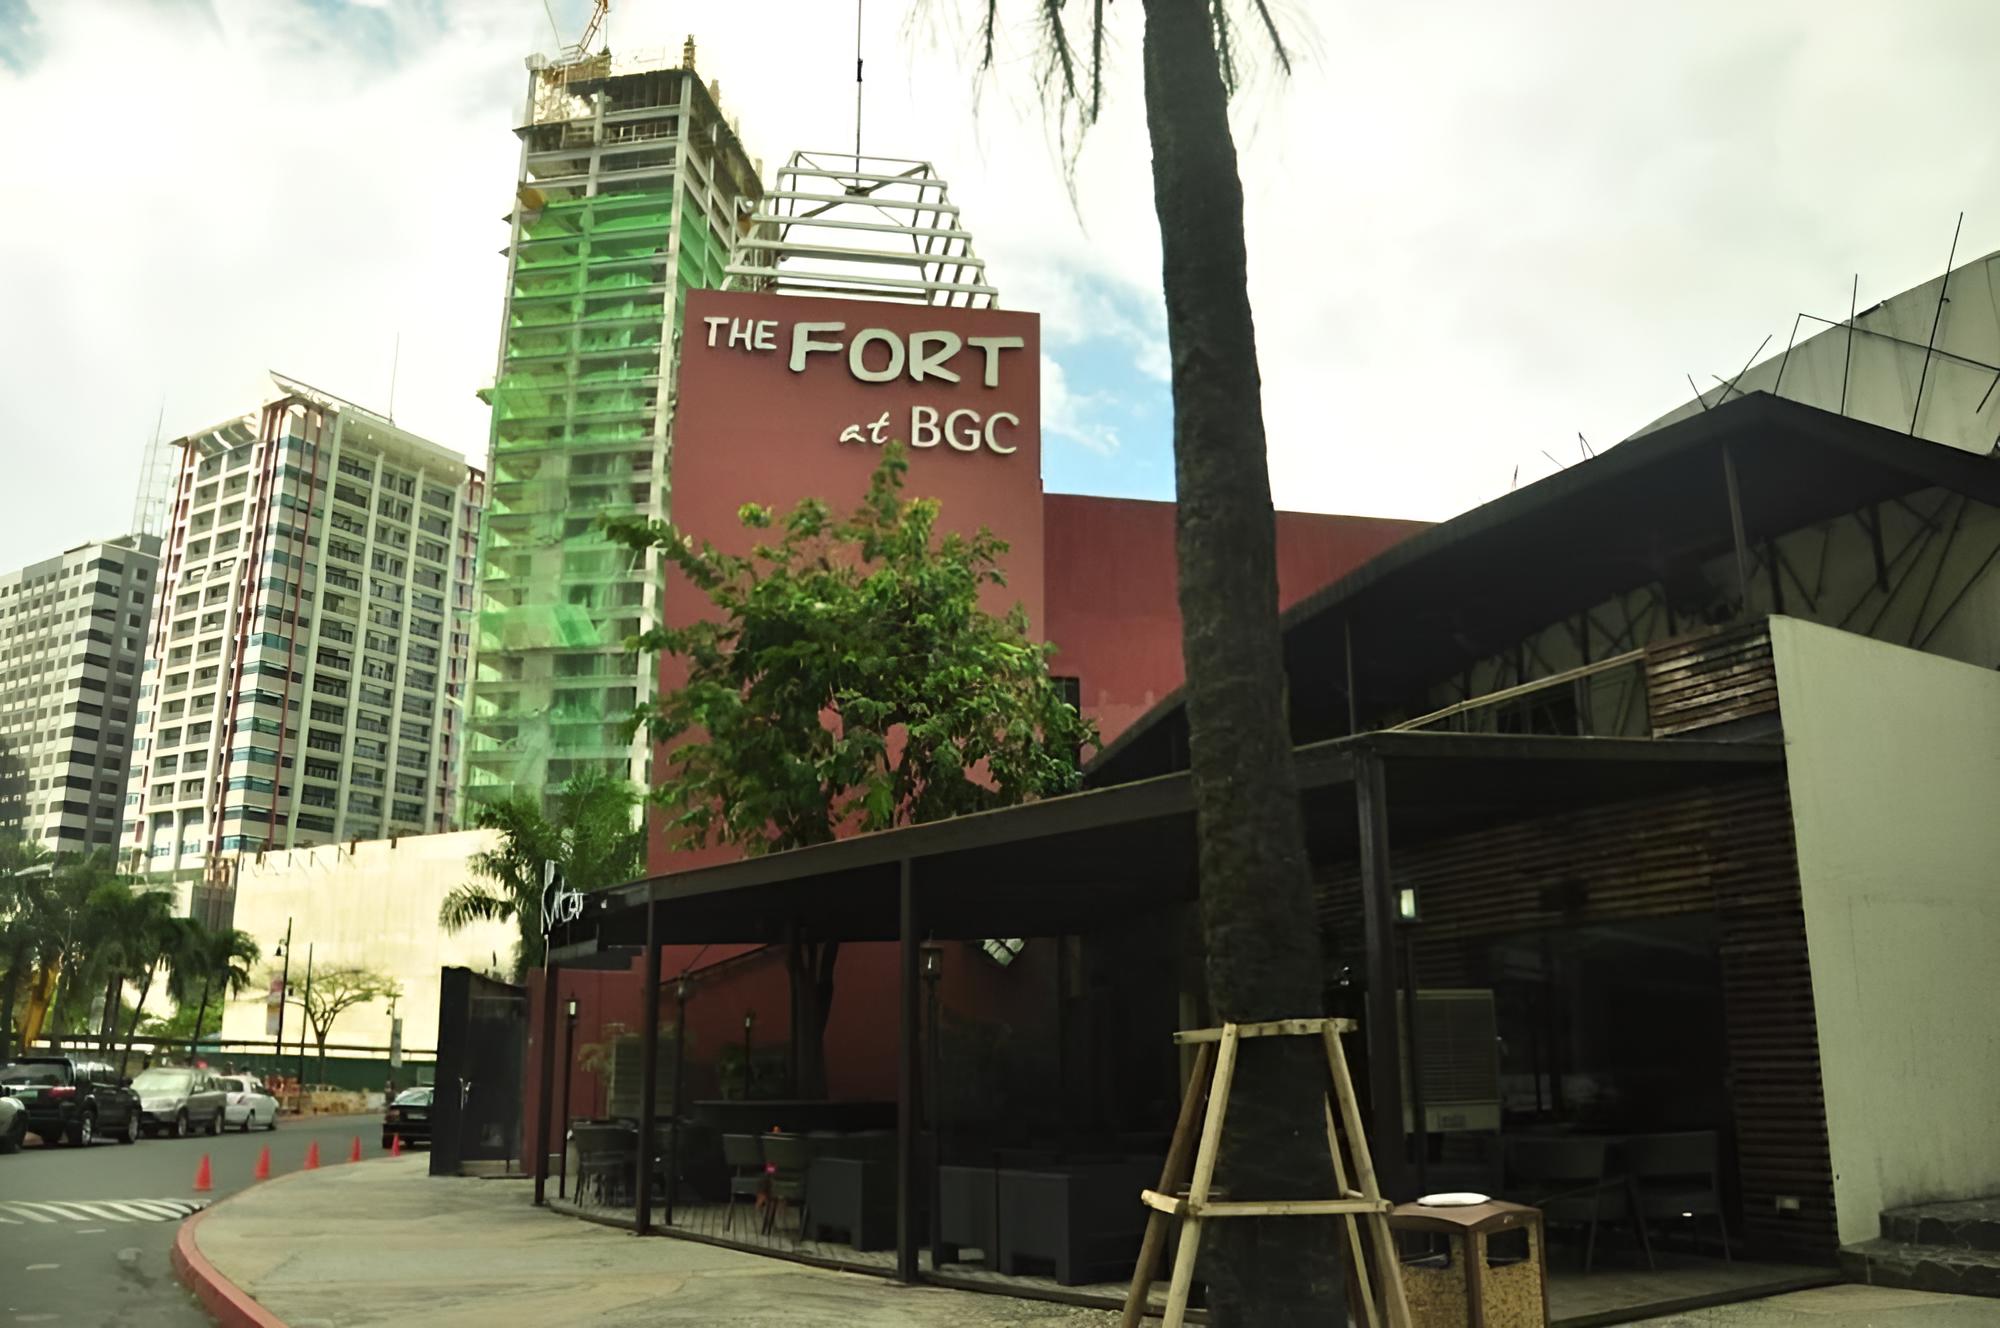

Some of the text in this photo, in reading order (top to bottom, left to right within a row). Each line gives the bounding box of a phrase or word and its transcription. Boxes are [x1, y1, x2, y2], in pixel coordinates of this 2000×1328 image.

[703, 316, 1025, 387] THE FORT
[839, 405, 1020, 454] at BGC
